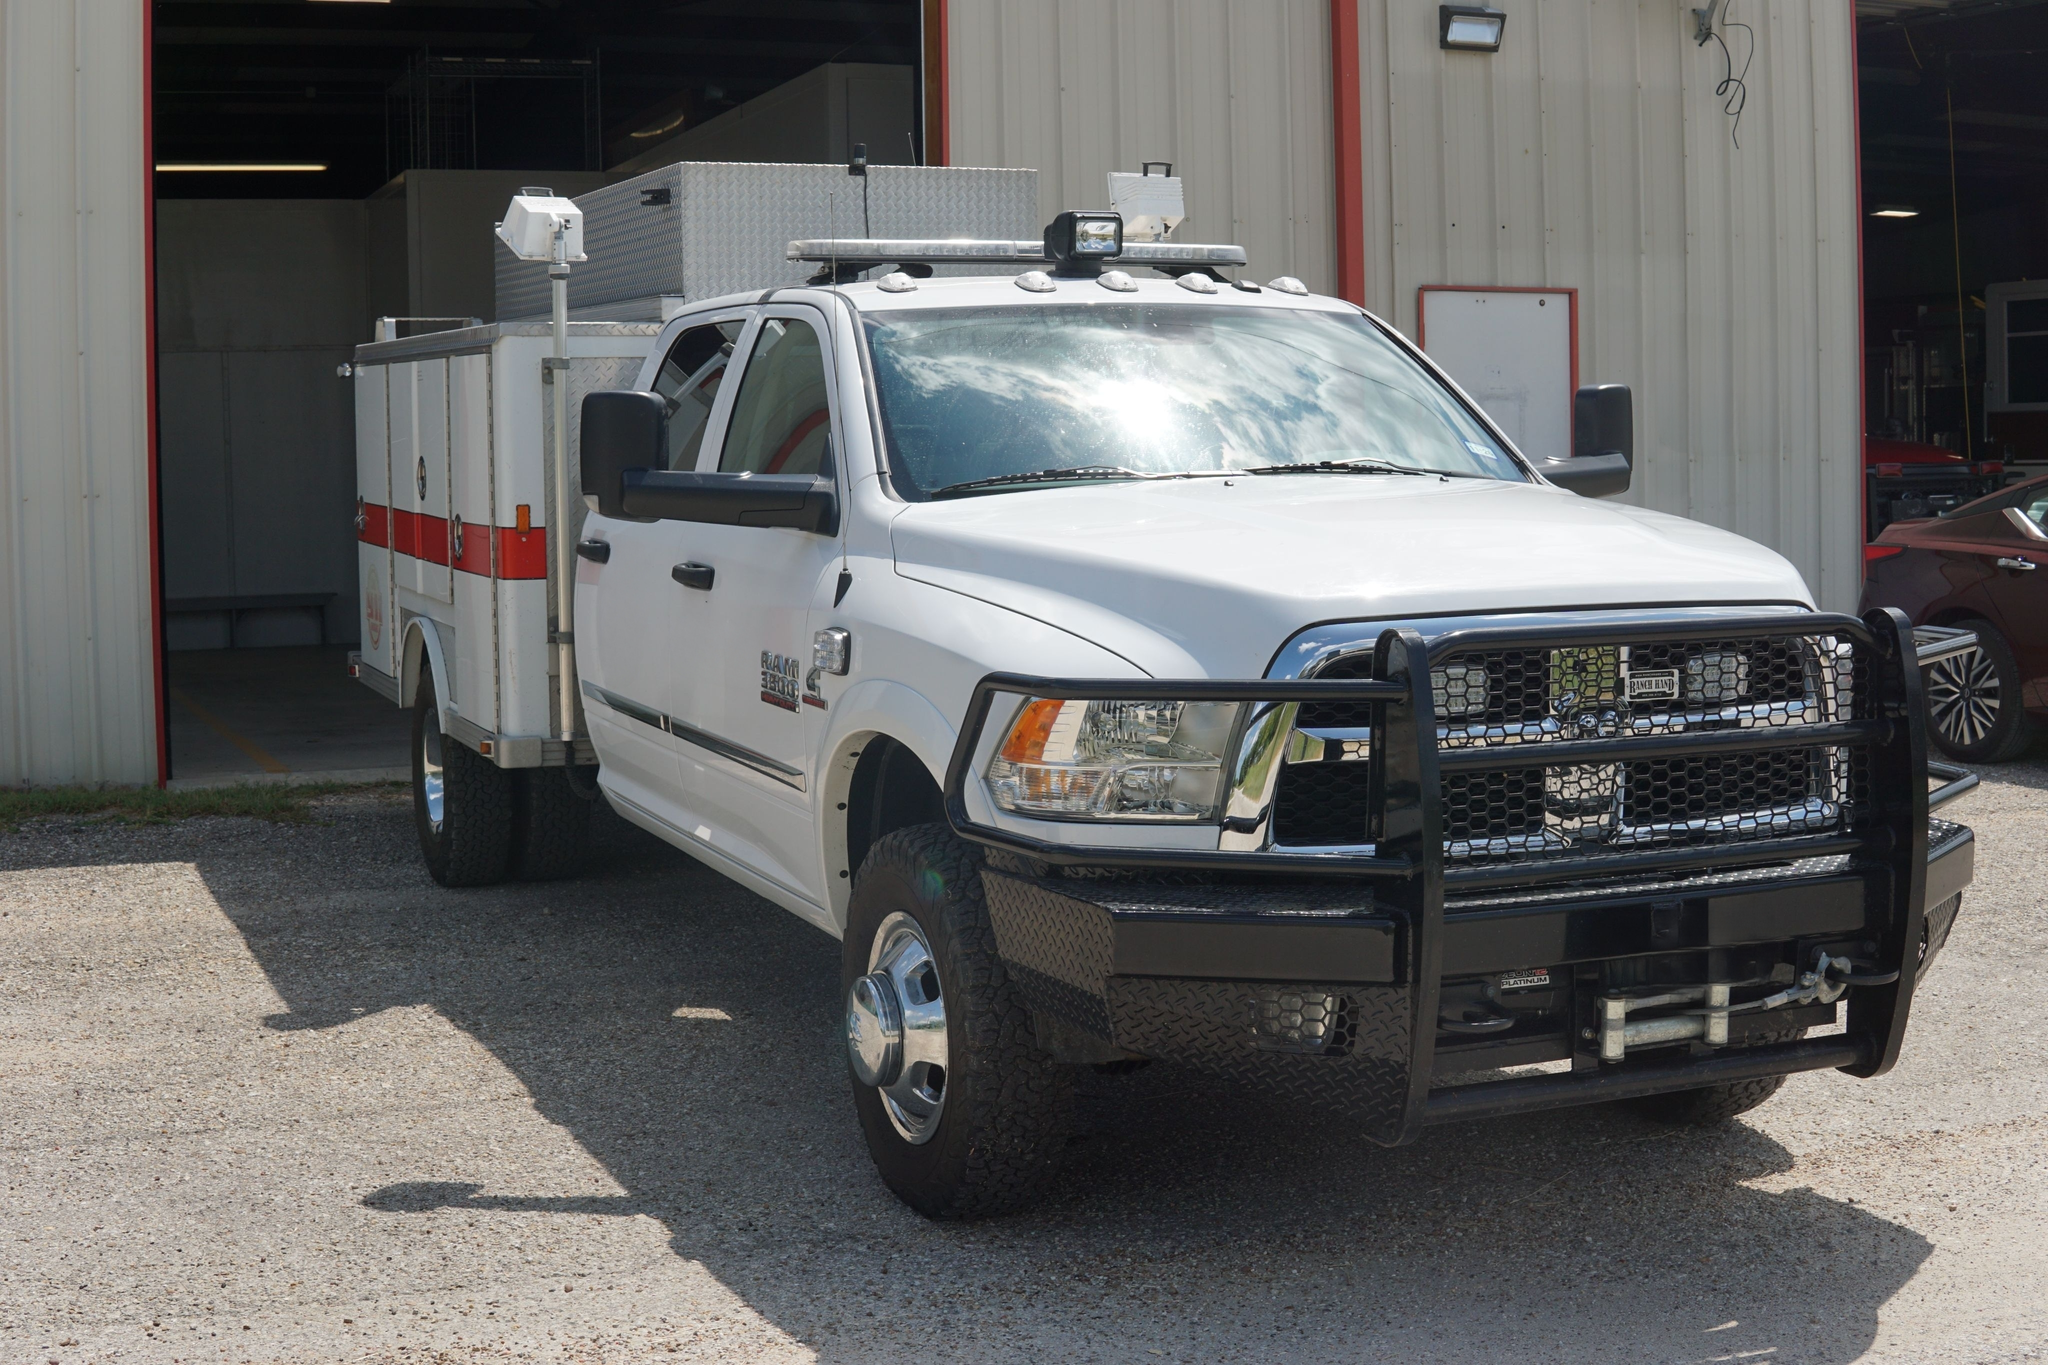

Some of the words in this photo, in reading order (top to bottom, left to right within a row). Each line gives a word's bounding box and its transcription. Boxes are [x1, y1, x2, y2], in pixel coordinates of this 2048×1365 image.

[761, 651, 799, 679] RAM
[761, 671, 799, 700] 3500
[1629, 679, 1653, 693] RANCH
[1655, 678, 1674, 691] HAND
[1501, 977, 1547, 987] PLATINUM
